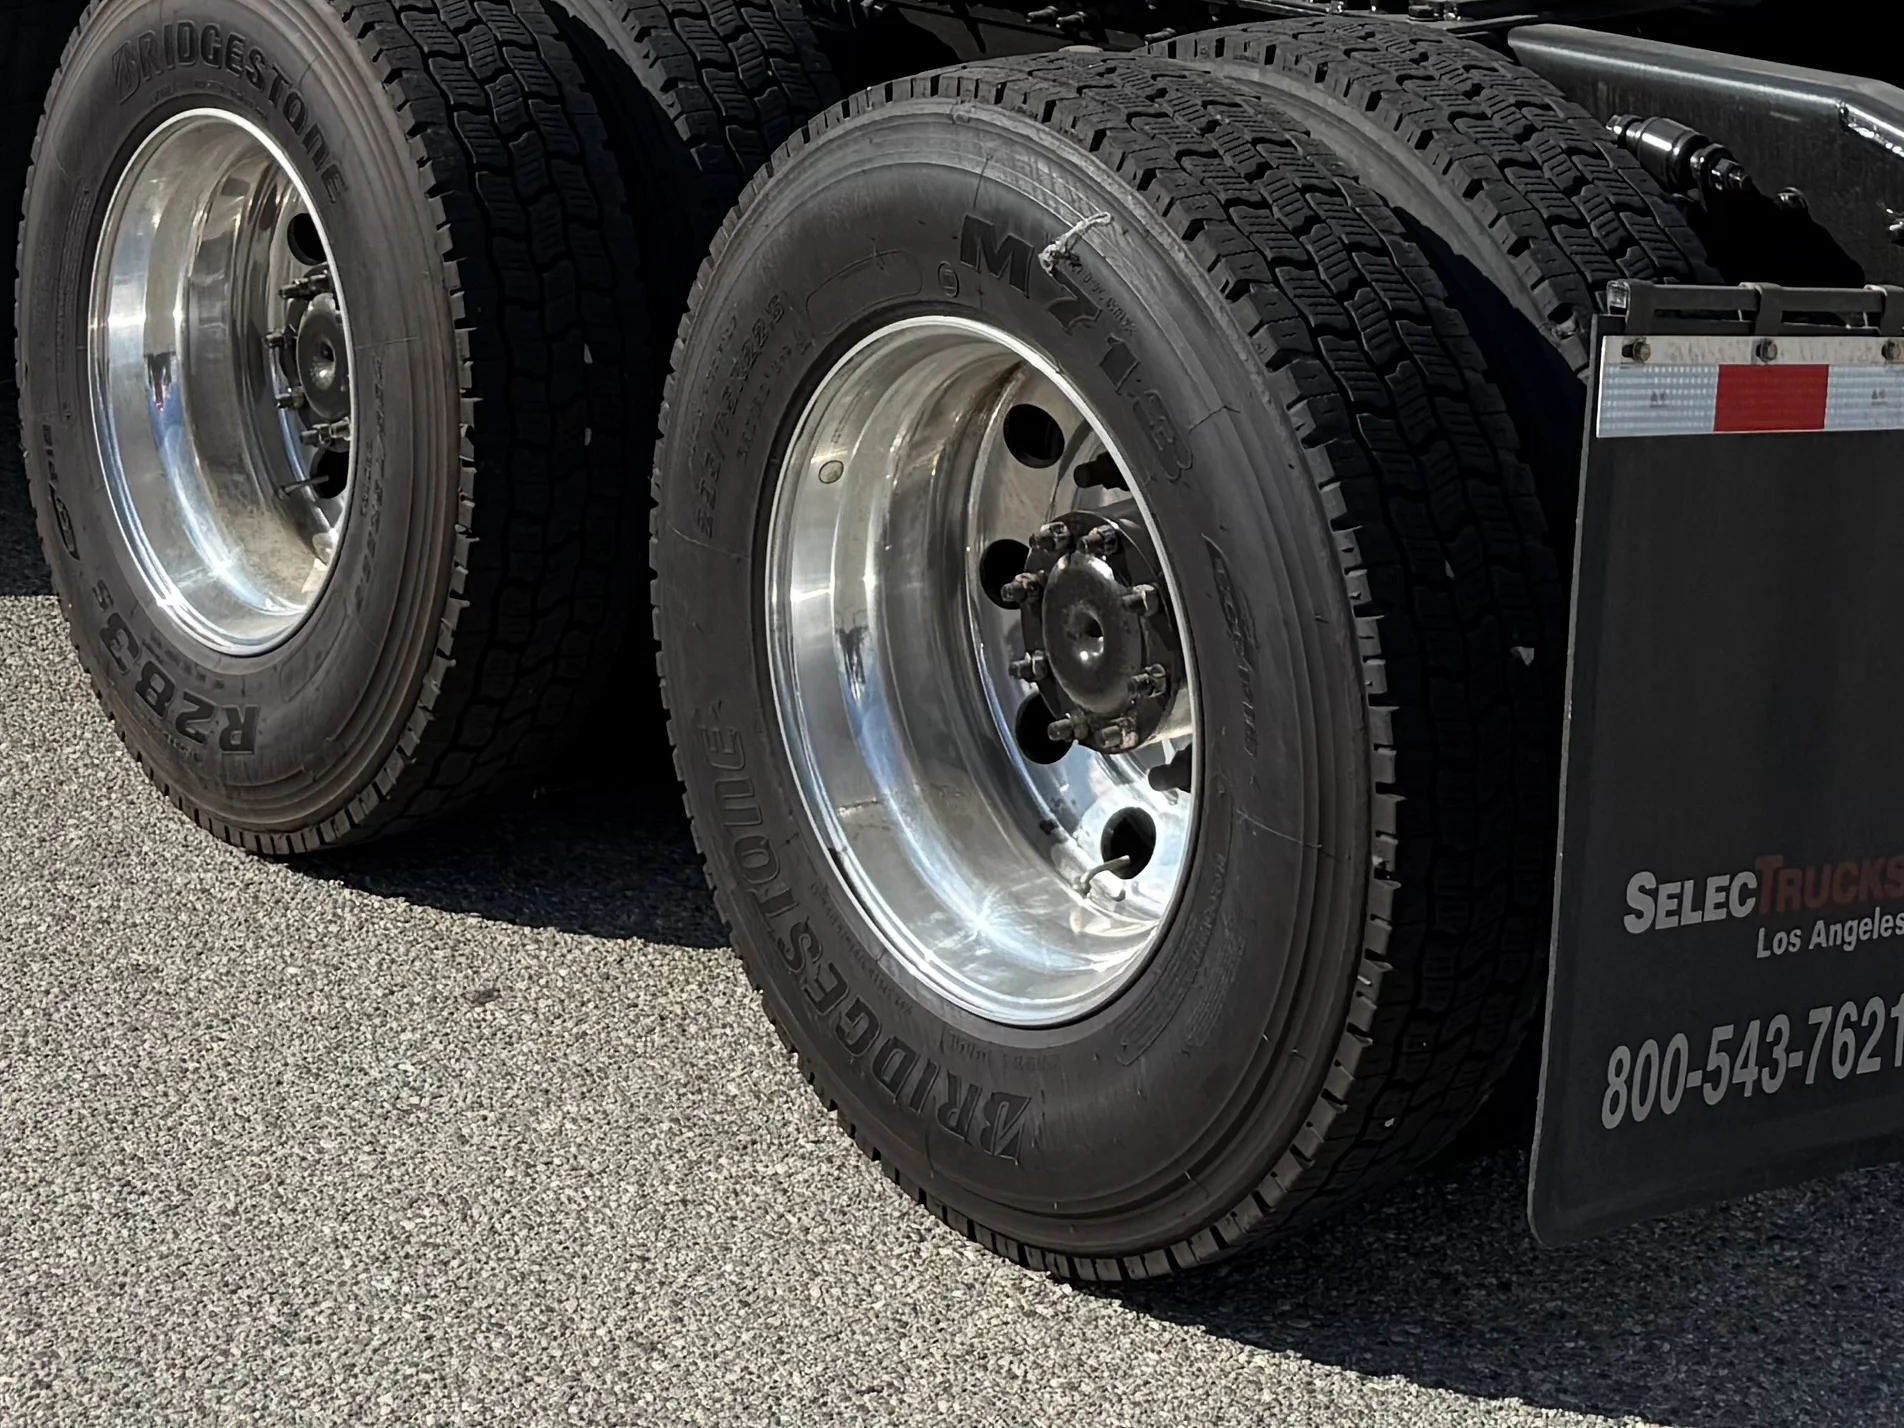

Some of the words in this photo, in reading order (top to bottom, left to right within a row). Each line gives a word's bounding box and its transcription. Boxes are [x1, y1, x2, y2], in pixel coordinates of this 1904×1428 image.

[111, 19, 348, 205] BRIDGESTONE
[700, 724, 1032, 1164] BRIDGESTONE
[1756, 926, 1802, 959] Los
